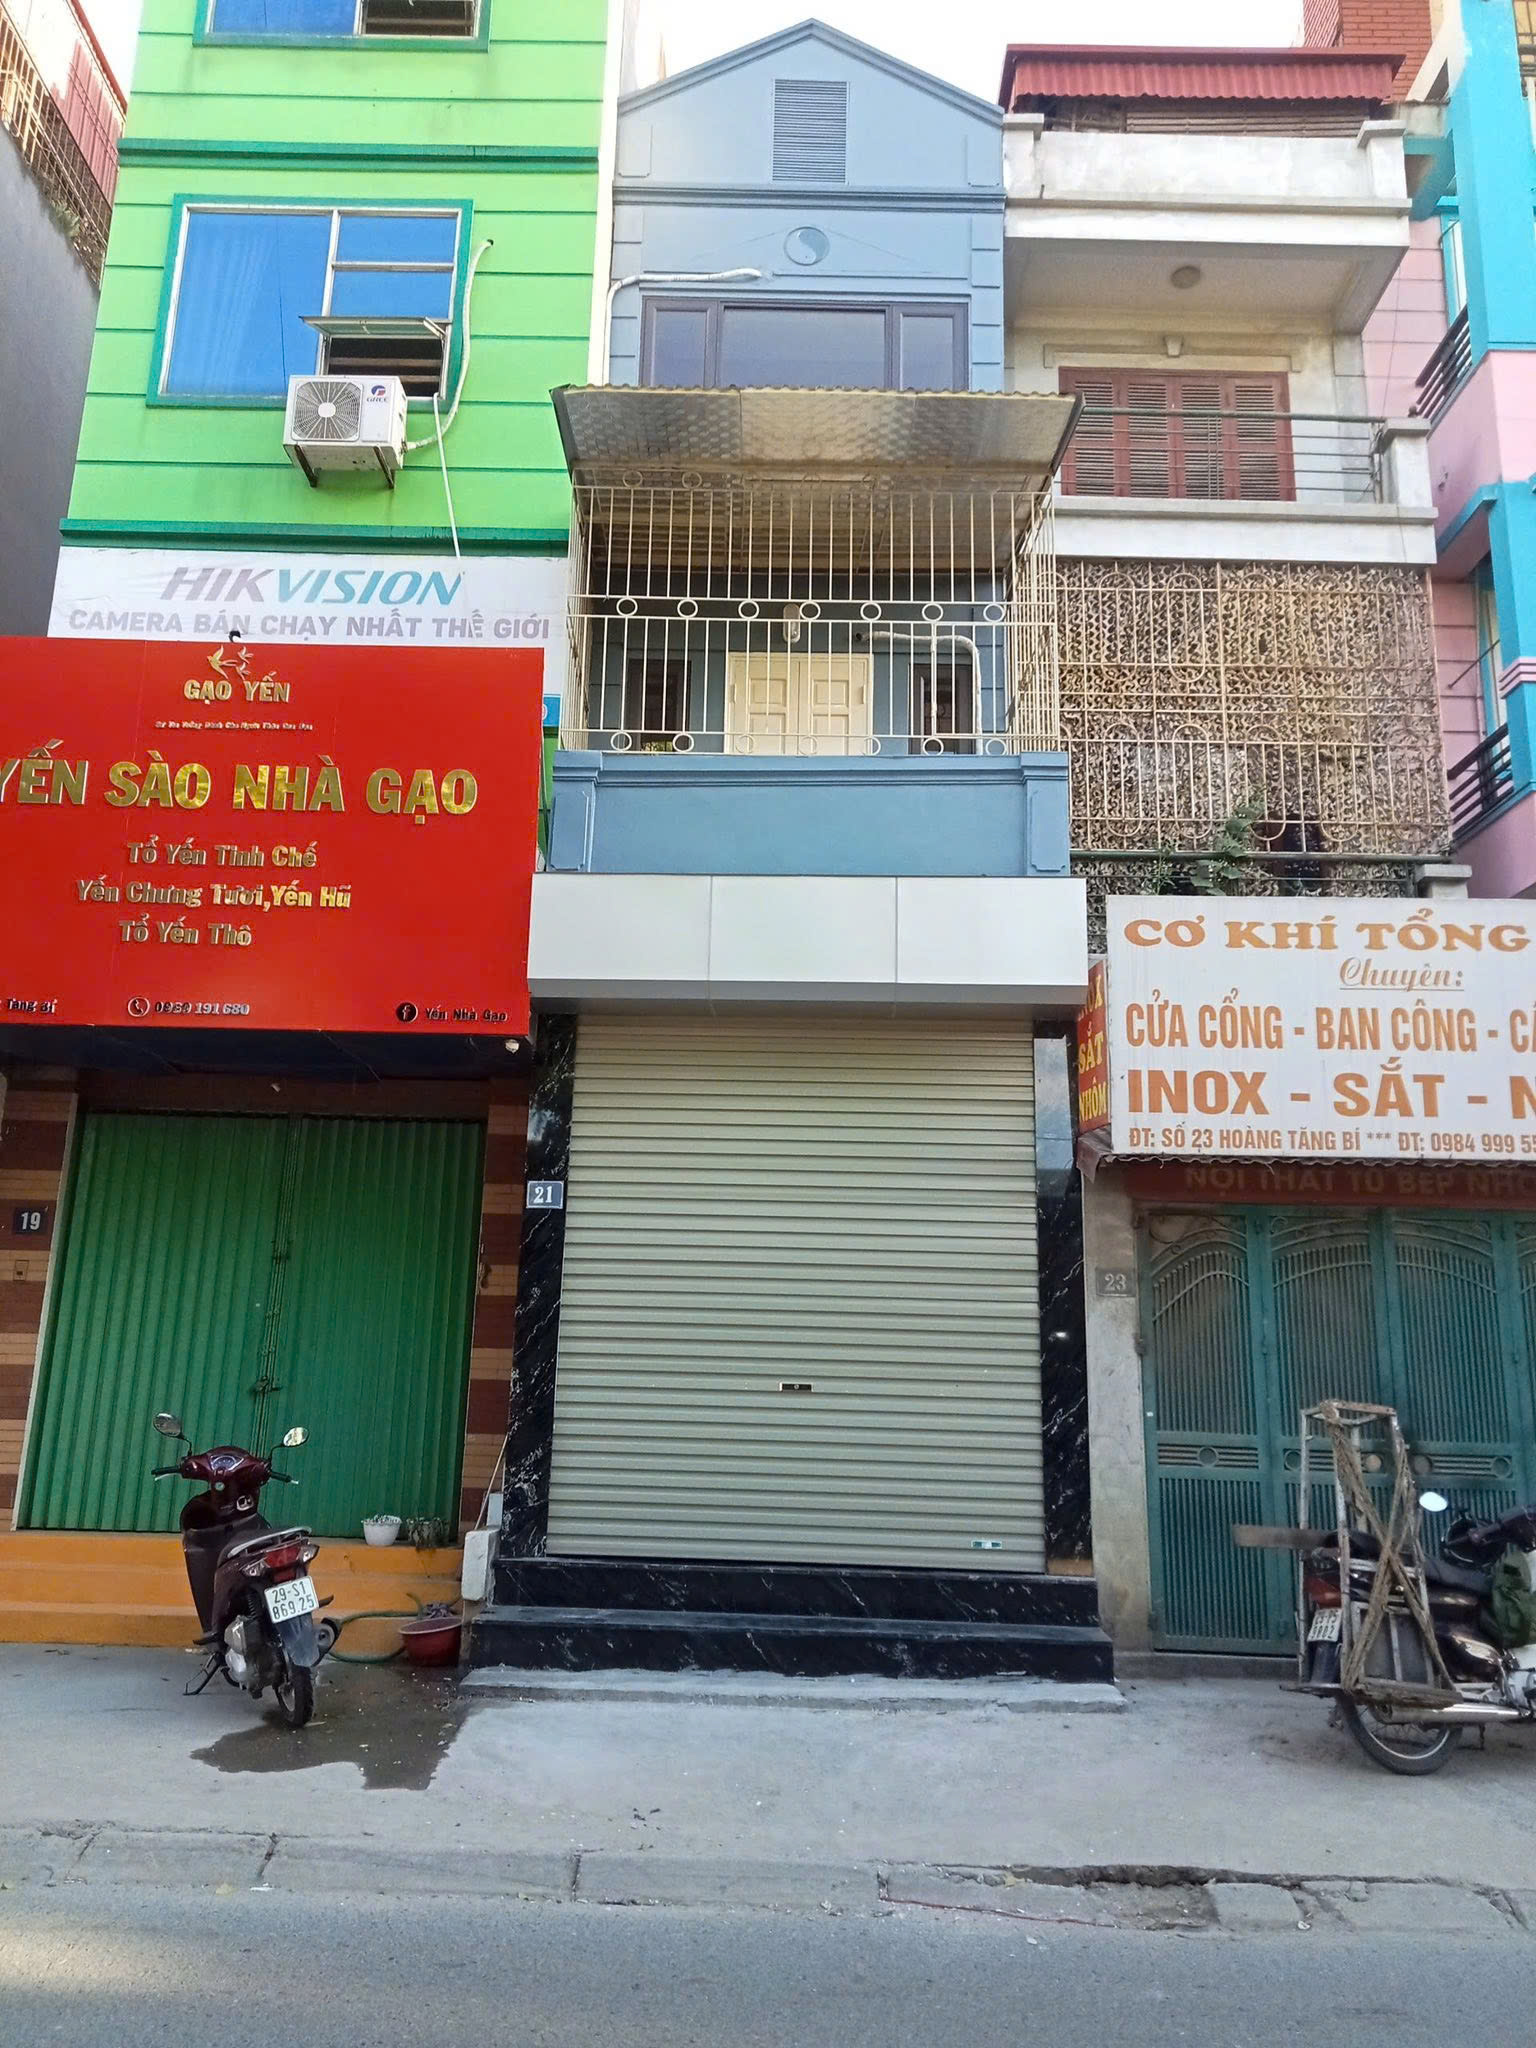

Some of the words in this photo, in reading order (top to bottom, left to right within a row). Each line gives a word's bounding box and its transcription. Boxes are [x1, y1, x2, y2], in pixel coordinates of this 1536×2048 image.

[160, 567, 462, 606] HIKVISION
[69, 609, 183, 633] CAMERA
[193, 609, 250, 636] BÁN
[260, 615, 338, 641] CHẠY
[346, 608, 422, 638] NHẤT
[432, 609, 484, 638] THẾ
[494, 613, 550, 639] GIỚI
[184, 679, 232, 704] GẠO
[244, 671, 291, 703] YẾN
[104, 750, 211, 810] SÀO
[232, 755, 345, 812] NHÀ
[366, 768, 478, 824] GẠO
[127, 834, 160, 864] Tổ
[166, 837, 206, 866] Yến
[272, 841, 318, 868] Chế
[77, 875, 119, 903] Yến
[126, 880, 202, 908] Chưng
[320, 884, 351, 908] Hũ
[119, 912, 150, 943] Tổ
[157, 915, 199, 945] Yến
[208, 923, 252, 946] Thô
[1124, 915, 1206, 947] CƠ
[1225, 915, 1338, 950] KHÍ
[1356, 908, 1532, 952] TỔNG
[1340, 956, 1463, 992] Chuyên:
[1126, 988, 1189, 1048] CỬA
[1198, 987, 1283, 1049] CỔNG
[1315, 1006, 1381, 1051] BAN
[1391, 999, 1478, 1052] CÔNG
[1079, 1077, 1108, 1123] NHÔM
[1127, 1069, 1270, 1116] INOX
[1333, 1057, 1445, 1117] SẮT
[1129, 1128, 1155, 1148] ĐT:
[1161, 1121, 1186, 1148] SỐ
[1191, 1129, 1213, 1148] 23
[1219, 1125, 1282, 1150] HOÀNG
[1288, 1127, 1336, 1151] TĂNG
[1342, 1127, 1361, 1151] BÍ
[1398, 1132, 1424, 1152] ĐT:
[1431, 1133, 1476, 1153] 0984
[1481, 1134, 1515, 1154] 999
[533, 1185, 552, 1203] 21
[21, 1212, 41, 1230] 19
[1104, 1273, 1126, 1290] 23
[272, 1581, 306, 1604] 29-S1
[272, 1594, 315, 1620] 869.25
